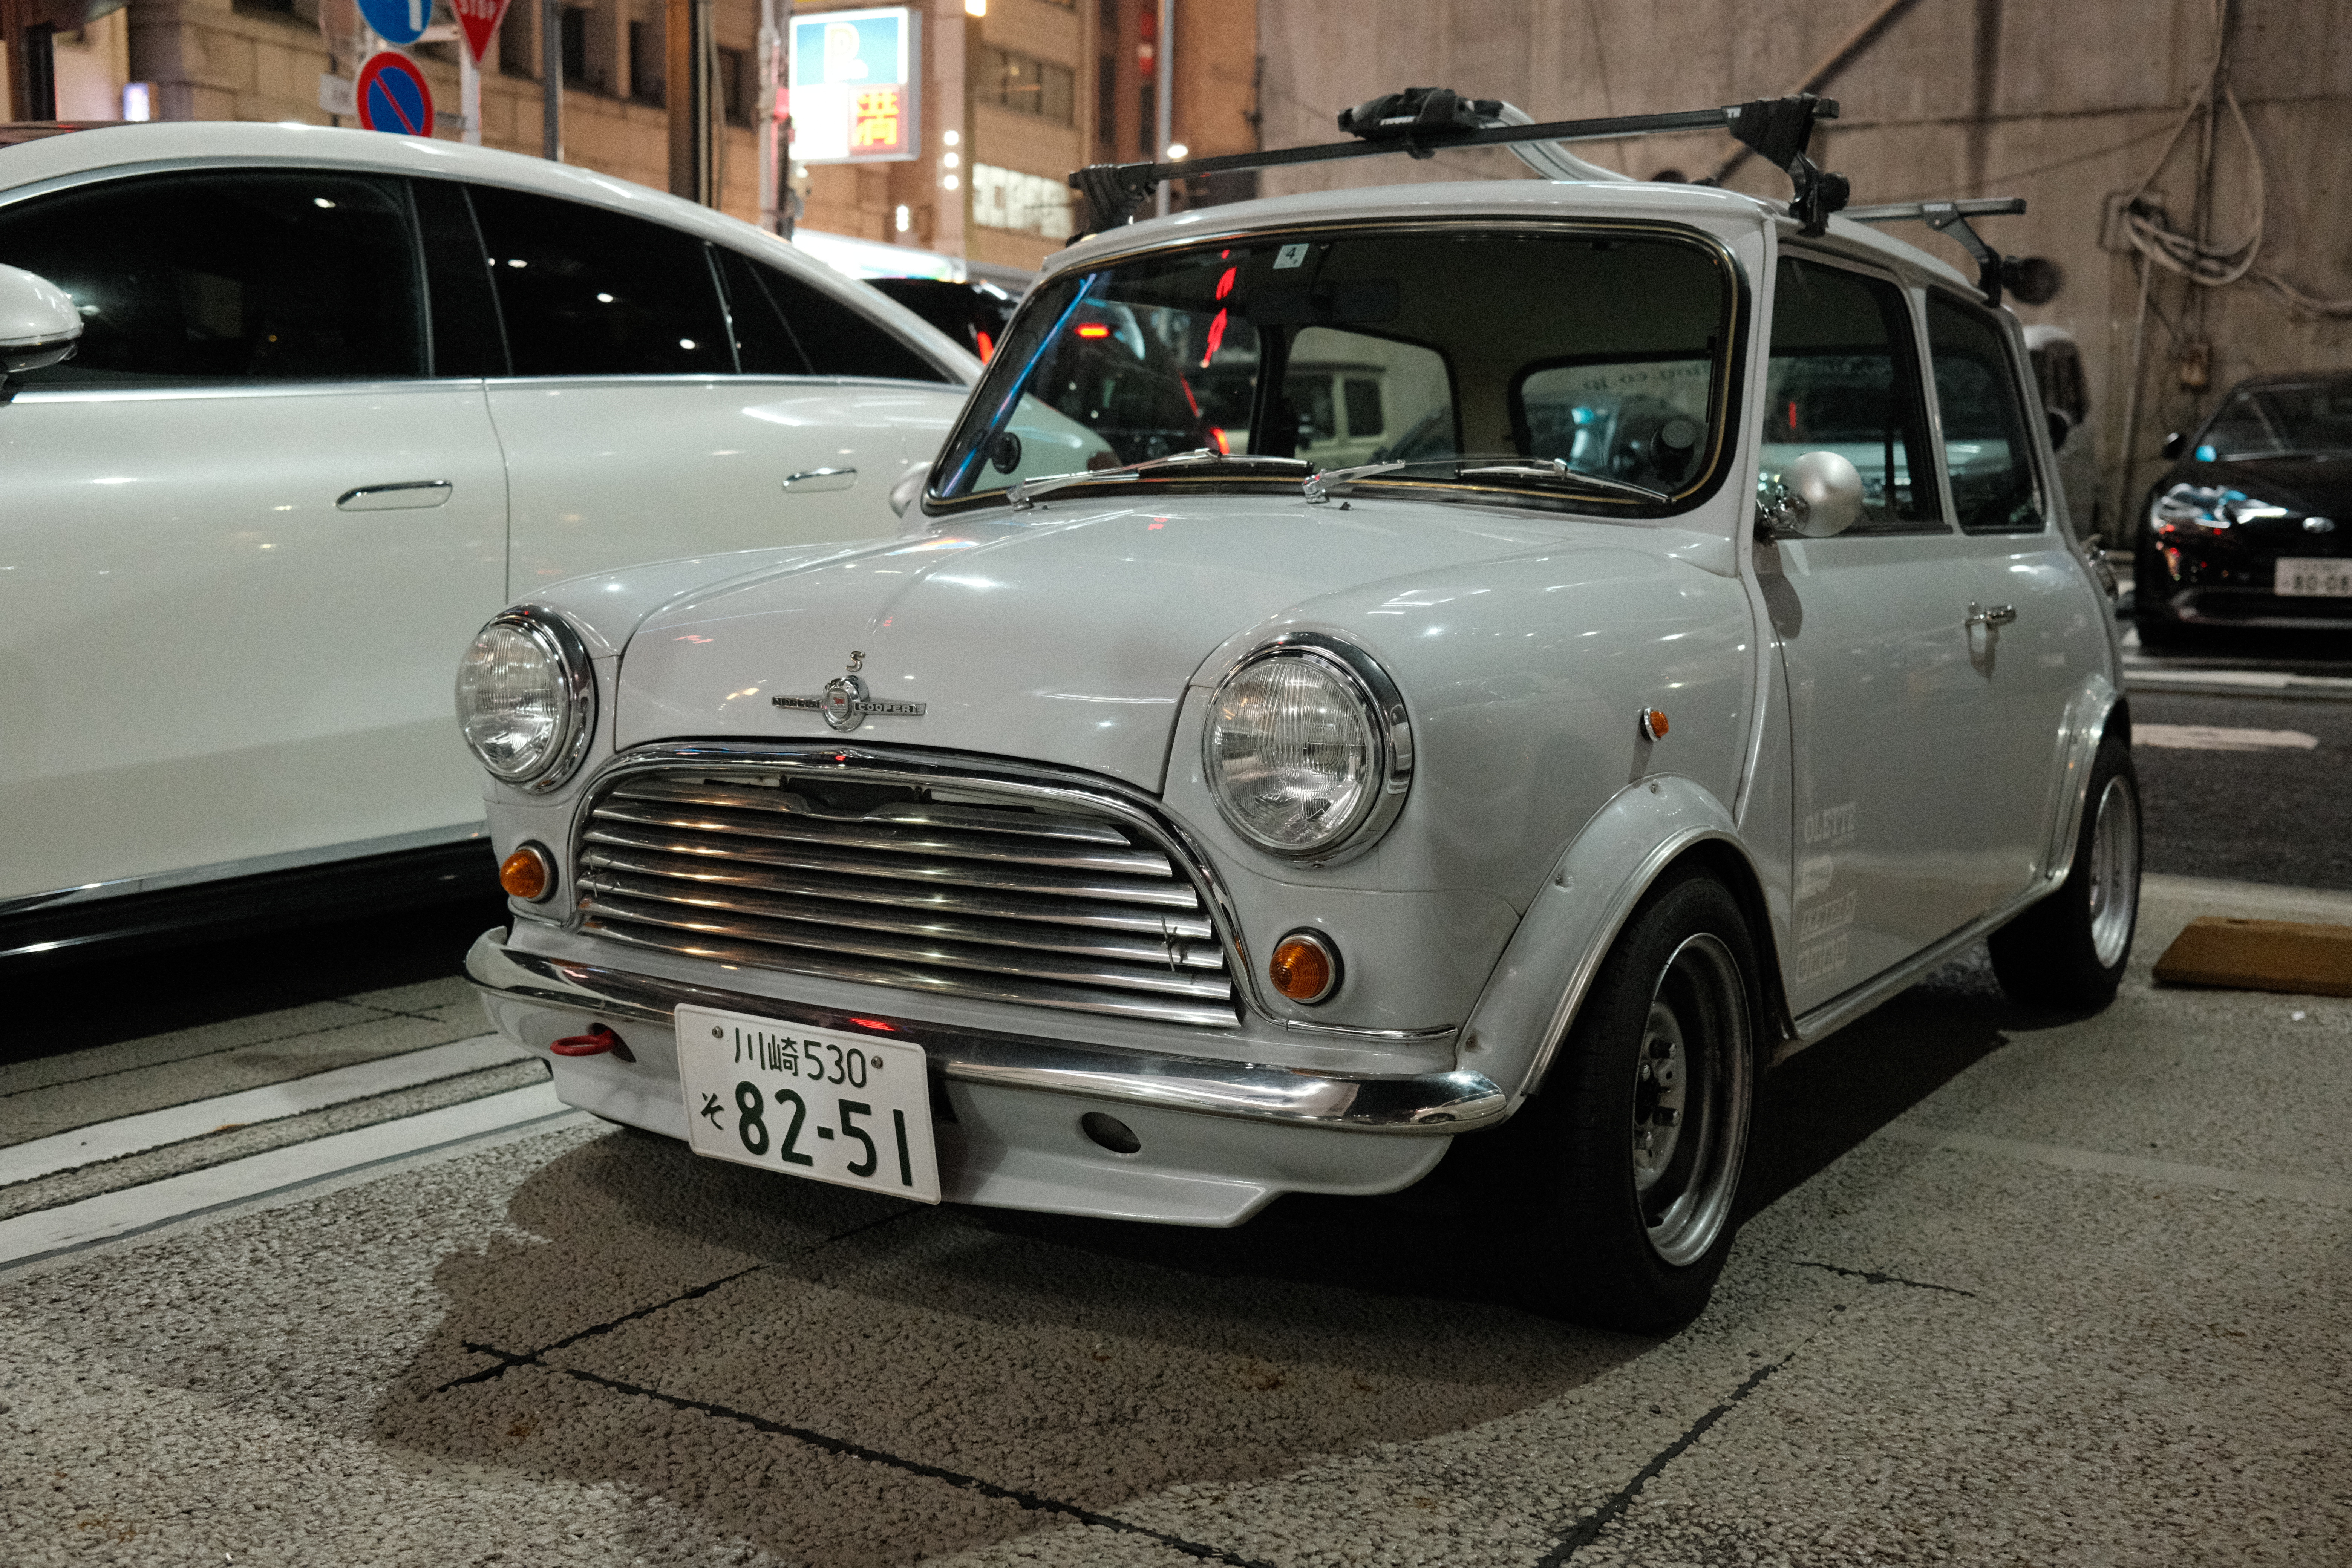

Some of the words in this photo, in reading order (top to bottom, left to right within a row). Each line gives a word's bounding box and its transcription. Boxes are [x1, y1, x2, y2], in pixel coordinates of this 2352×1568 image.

[1286, 247, 1297, 259] 4
[845, 651, 865, 672] S
[858, 703, 911, 713] COOPER
[735, 1027, 867, 1088] 川崎530
[735, 1080, 914, 1187] 82-51
